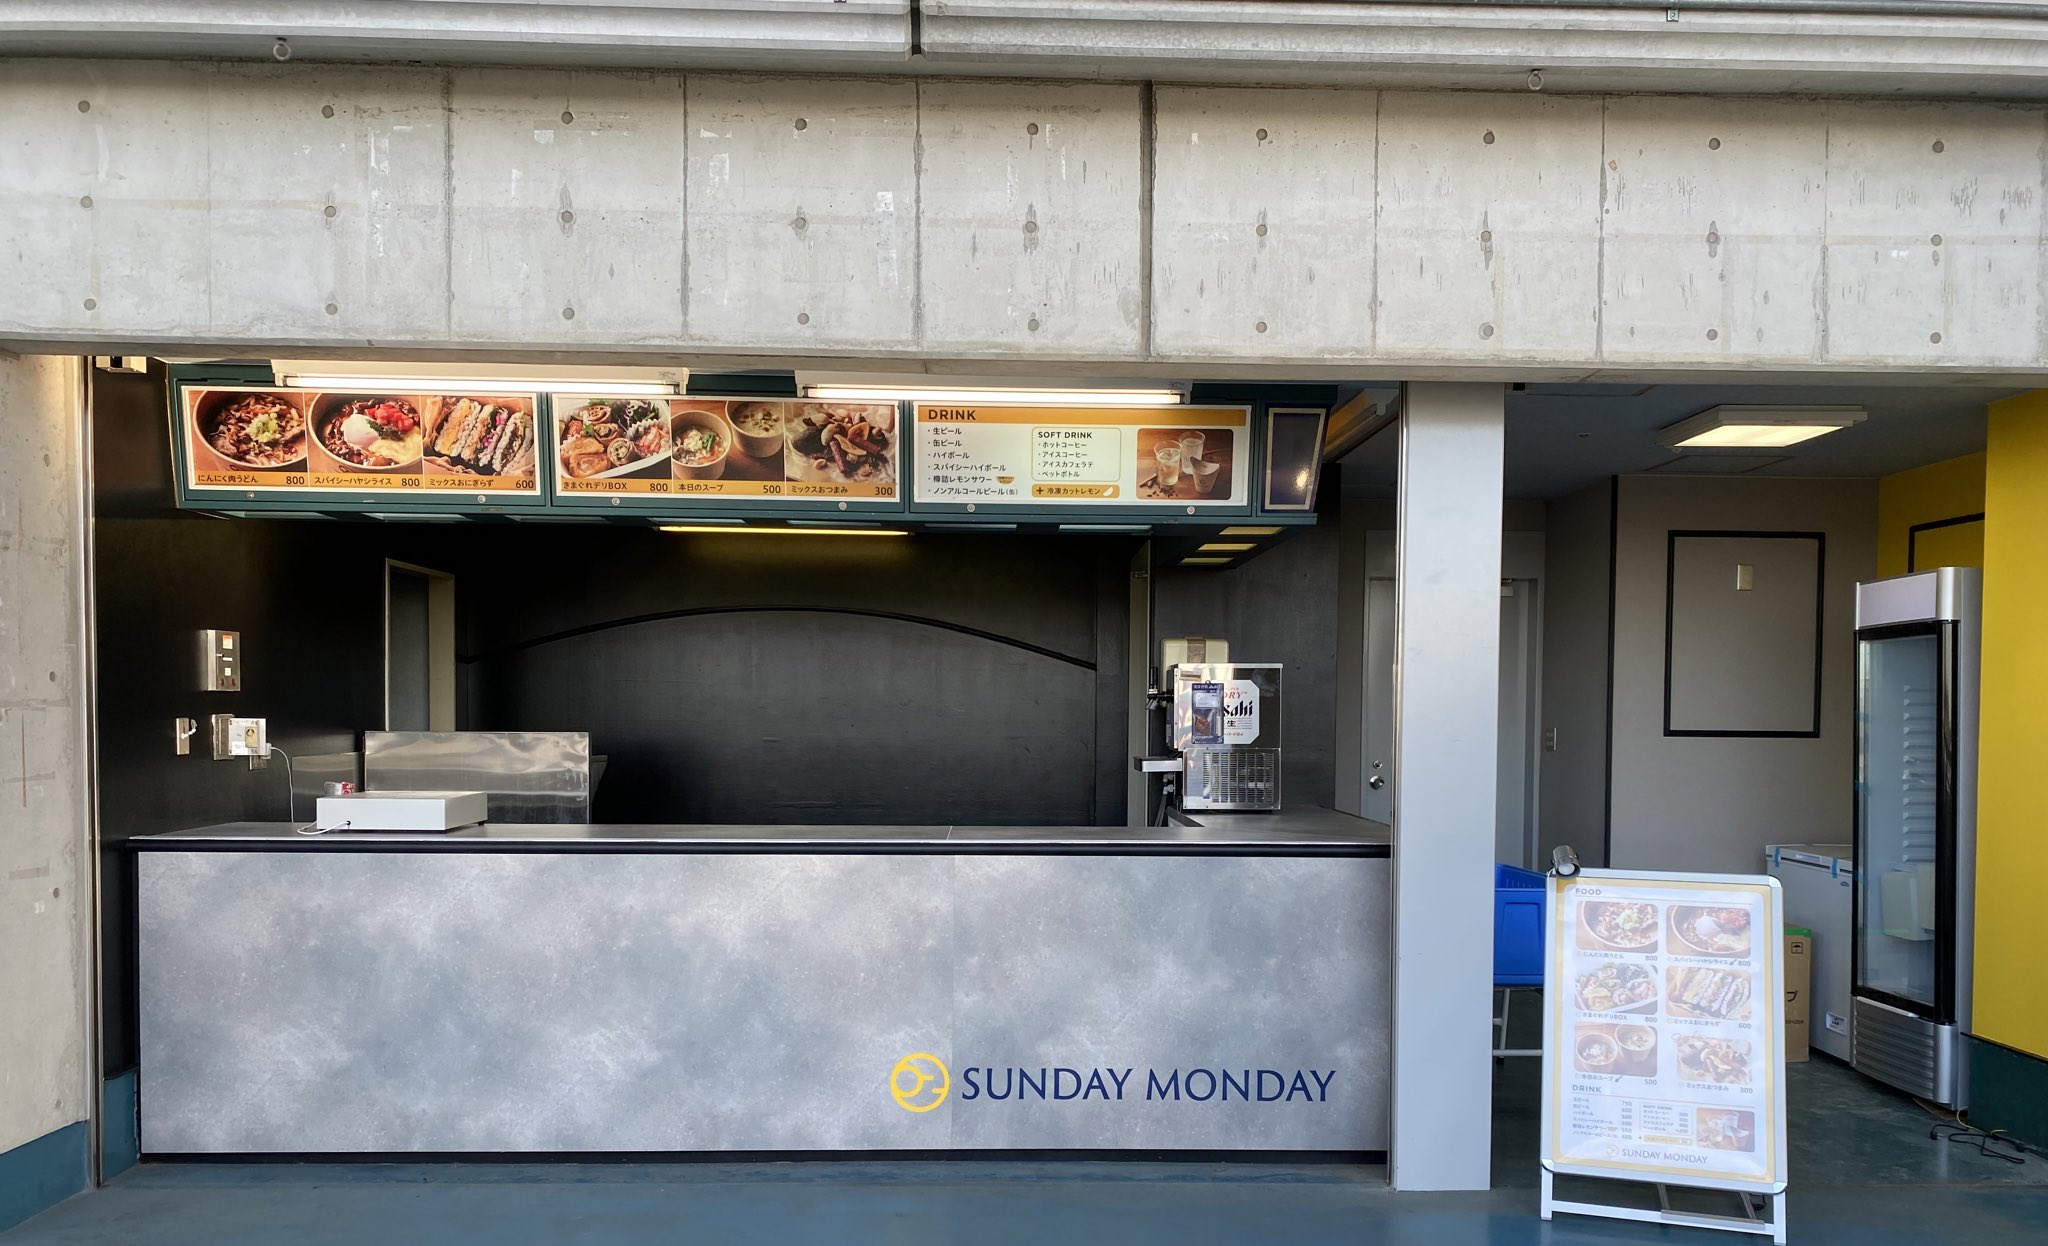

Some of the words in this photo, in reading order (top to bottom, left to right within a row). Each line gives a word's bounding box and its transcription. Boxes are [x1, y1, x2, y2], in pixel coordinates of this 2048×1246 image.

[928, 409, 976, 420] DRINK
[933, 427, 962, 435] 生ビール
[1038, 431, 1062, 439] SOFT
[1064, 431, 1093, 439] DRINK
[933, 439, 962, 447] 缶ビール
[933, 451, 970, 459] ハイボール
[933, 463, 1006, 472] スパイシーハイボール
[198, 475, 258, 483] にんにく肉うどん
[286, 476, 305, 485] 800
[314, 476, 392, 485] スパイシーハヤシライス
[401, 478, 420, 487] 800
[429, 478, 494, 487] ミックスおにぎらず
[515, 480, 534, 489] 600
[562, 481, 627, 490] きまぐれデリBOX
[649, 483, 668, 492] 800
[678, 483, 724, 492] 本日のスープ
[763, 485, 781, 494] 500
[791, 485, 849, 494] ミックスおつまみ
[875, 486, 893, 496] 300
[1046, 487, 1101, 495] 冷凍カットレモン
[1223, 700, 1253, 717] sahi
[1575, 888, 1602, 896] FOOD
[1738, 1022, 1752, 1030] 600
[961, 1067, 1133, 1101] SUNDAY
[1145, 1068, 1337, 1103] MONDAY
[1572, 1084, 1602, 1093] DRINK
[1622, 1148, 1661, 1159] SUNDAY
[1663, 1153, 1709, 1164] MONDAY
